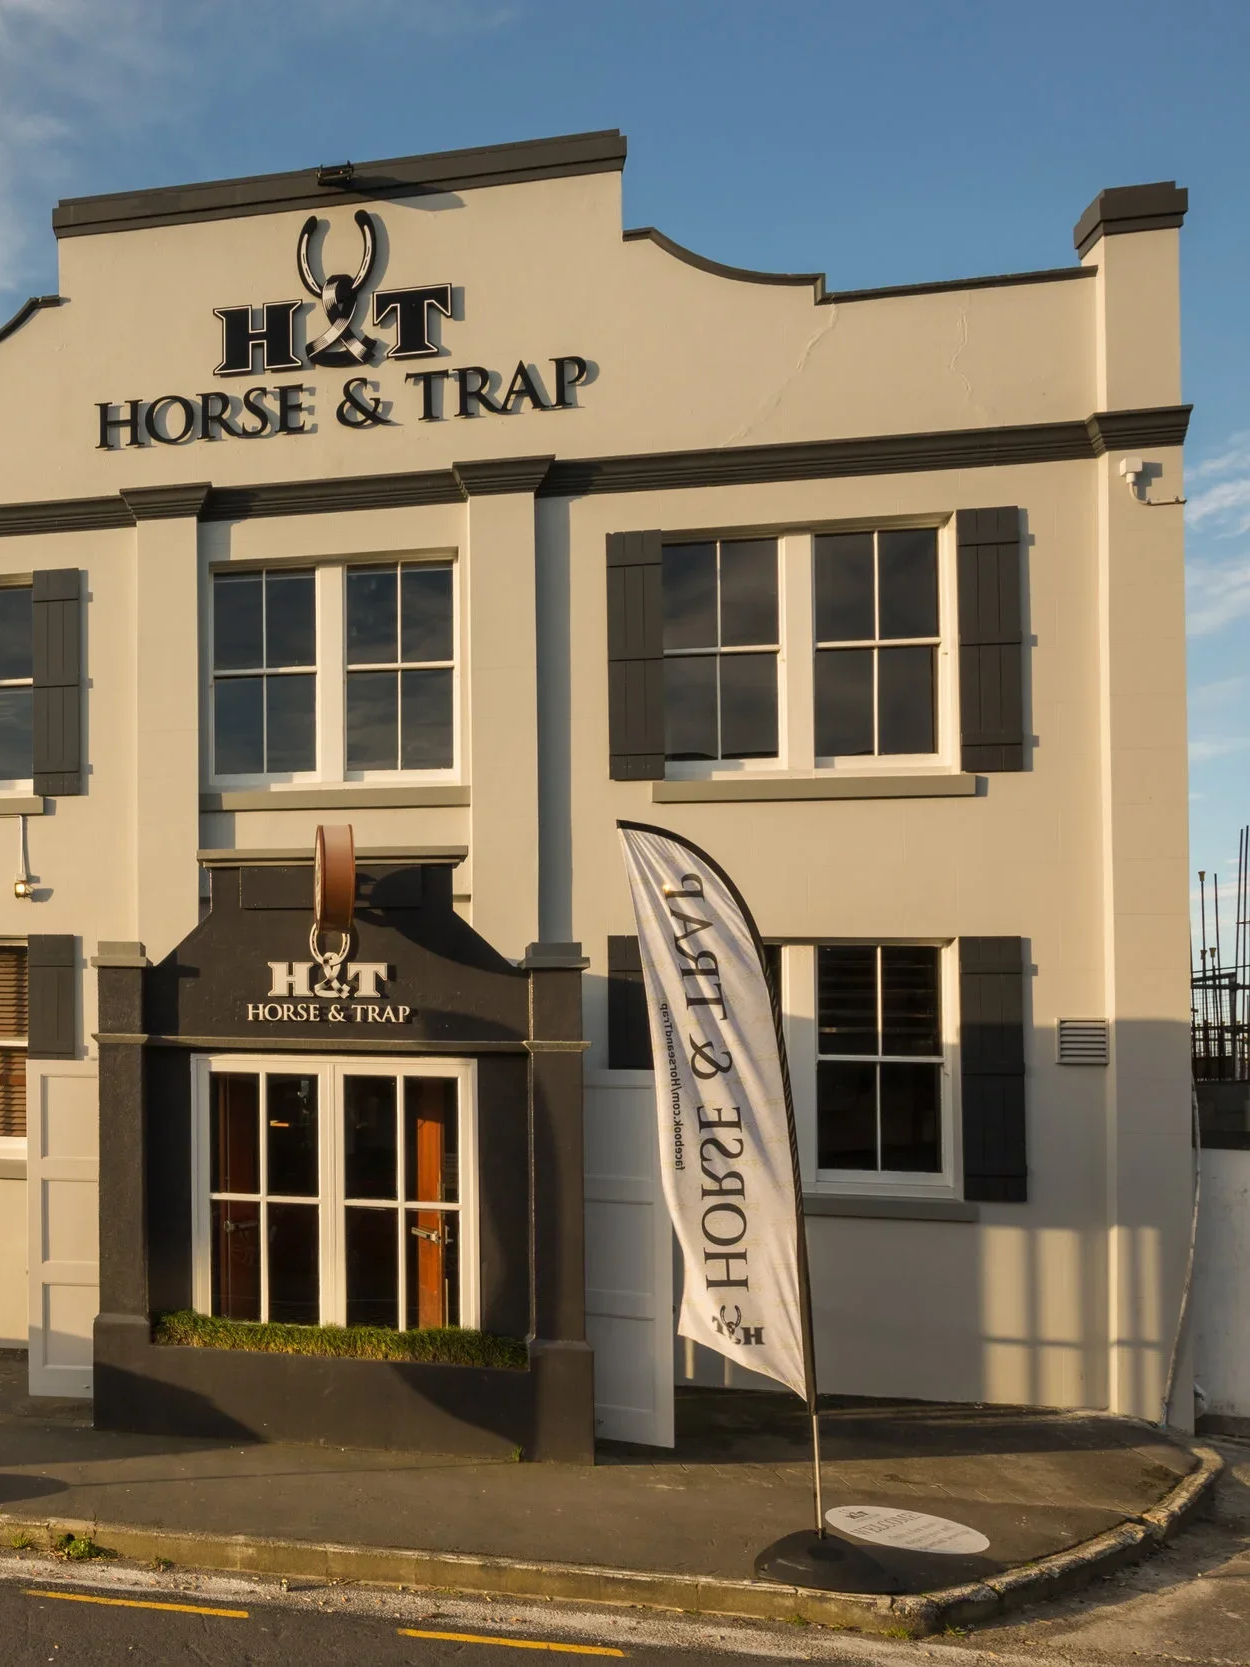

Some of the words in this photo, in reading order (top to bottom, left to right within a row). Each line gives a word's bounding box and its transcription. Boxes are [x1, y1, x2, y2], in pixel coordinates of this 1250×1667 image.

[94, 383, 307, 449] HORSE
[336, 377, 392, 429] &
[404, 355, 587, 422] TRAP
[246, 1004, 320, 1021] HORSE
[328, 1004, 346, 1022] &
[351, 1005, 411, 1023] TRAP
